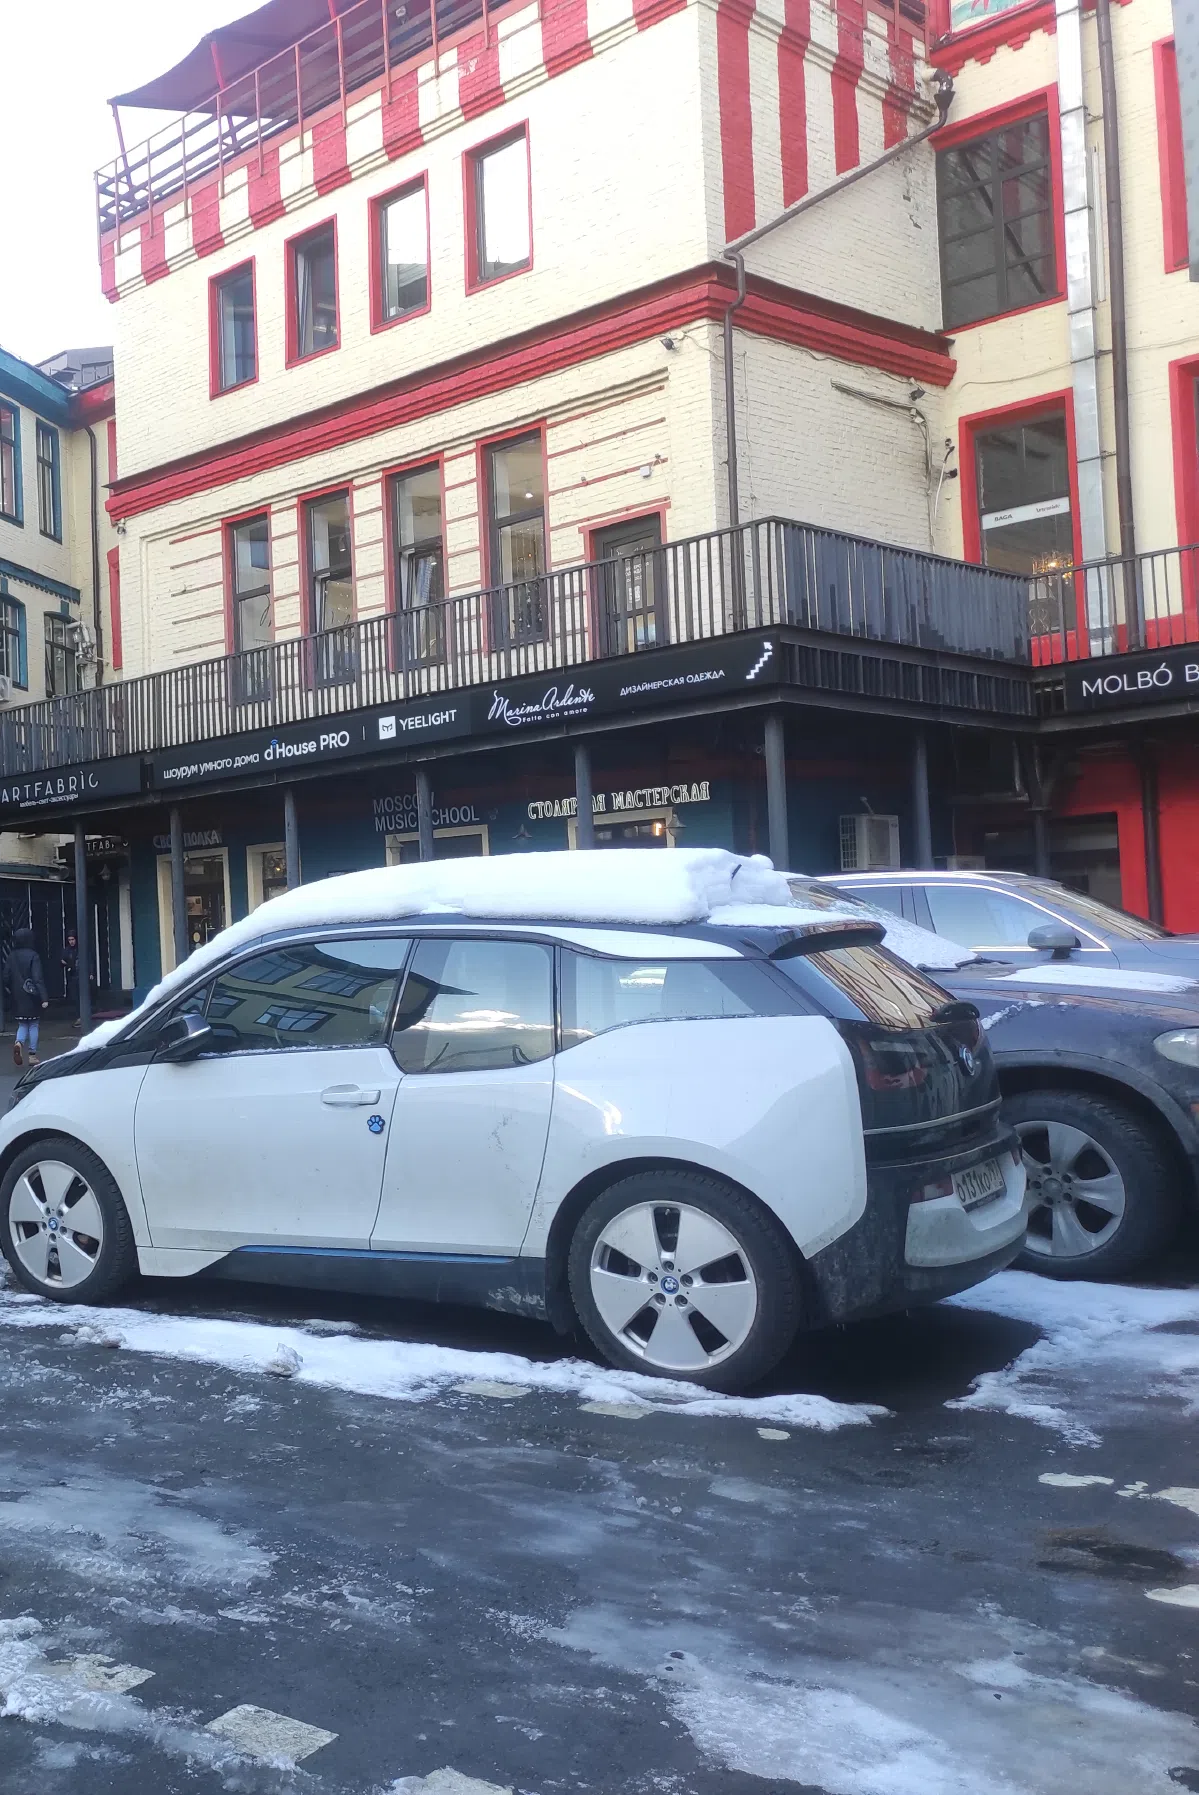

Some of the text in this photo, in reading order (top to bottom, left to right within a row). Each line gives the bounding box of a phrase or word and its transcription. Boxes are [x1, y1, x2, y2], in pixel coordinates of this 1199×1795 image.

[619, 669, 726, 696] ДИЗАЙНЕРСКАЯ ОДЕЖДА
[1082, 662, 1173, 697] MOLBÓ
[399, 709, 458, 731] YEELIGHT
[487, 689, 543, 726] Marina
[319, 730, 350, 752] PRO
[163, 752, 260, 780] шоурум умного дома
[373, 791, 435, 815] MOSCO
[528, 781, 711, 820] СТОЛЯРАЯ МАСТЕРСКАЯ
[374, 805, 480, 832] MUSIC CHOOL
